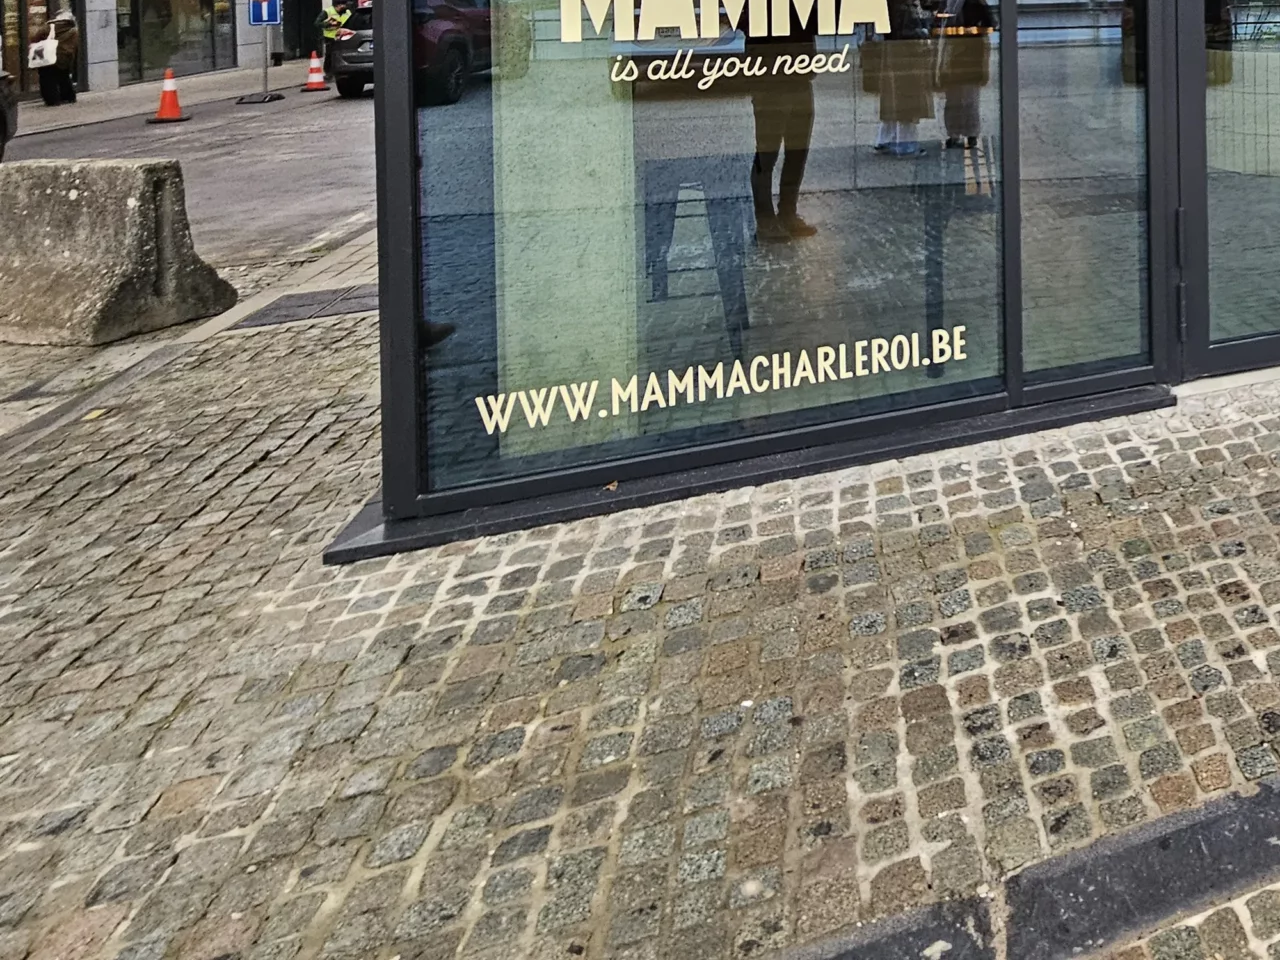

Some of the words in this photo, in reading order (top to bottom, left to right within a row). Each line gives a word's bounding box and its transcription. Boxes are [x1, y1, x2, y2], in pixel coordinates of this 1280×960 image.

[610, 54, 639, 82] is
[647, 48, 695, 80] all
[697, 55, 767, 90] you
[771, 43, 850, 75] need
[475, 325, 967, 436] WWW.MAMMACHARLEROI.BE
